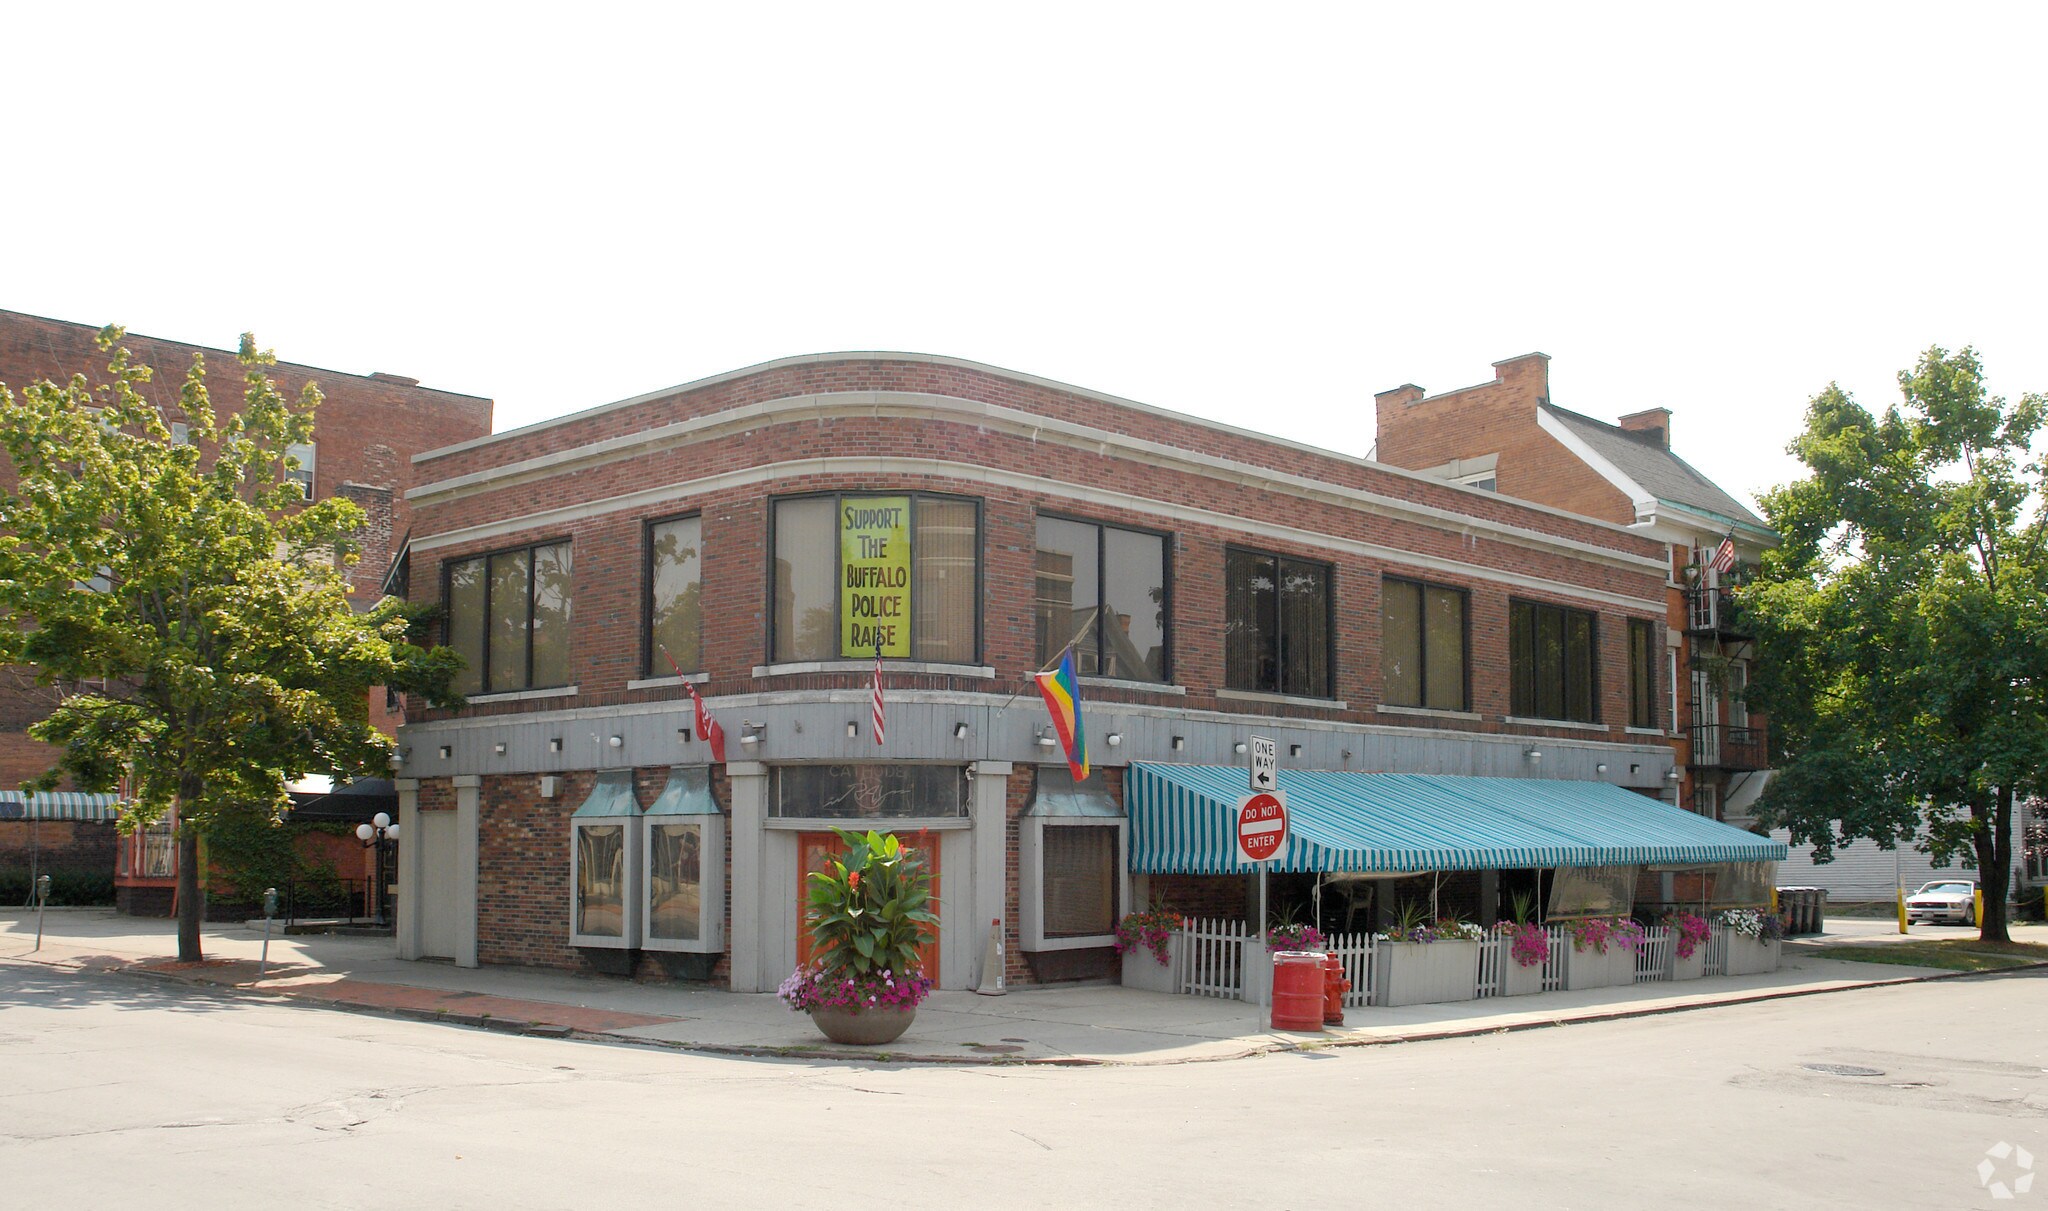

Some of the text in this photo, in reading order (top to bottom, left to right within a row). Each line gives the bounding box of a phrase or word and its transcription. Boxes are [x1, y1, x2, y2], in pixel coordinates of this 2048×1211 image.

[845, 506, 902, 530] SUPPORT
[857, 535, 887, 559] THE
[846, 564, 907, 588] BUFFALO
[851, 593, 902, 618] POLICE
[851, 623, 896, 648] RAISE
[1255, 741, 1273, 756] ONE
[829, 765, 905, 778] CATHODE
[1255, 756, 1274, 770] WAY
[1245, 805, 1278, 820] DO NOT
[1248, 835, 1275, 849] ENTER
